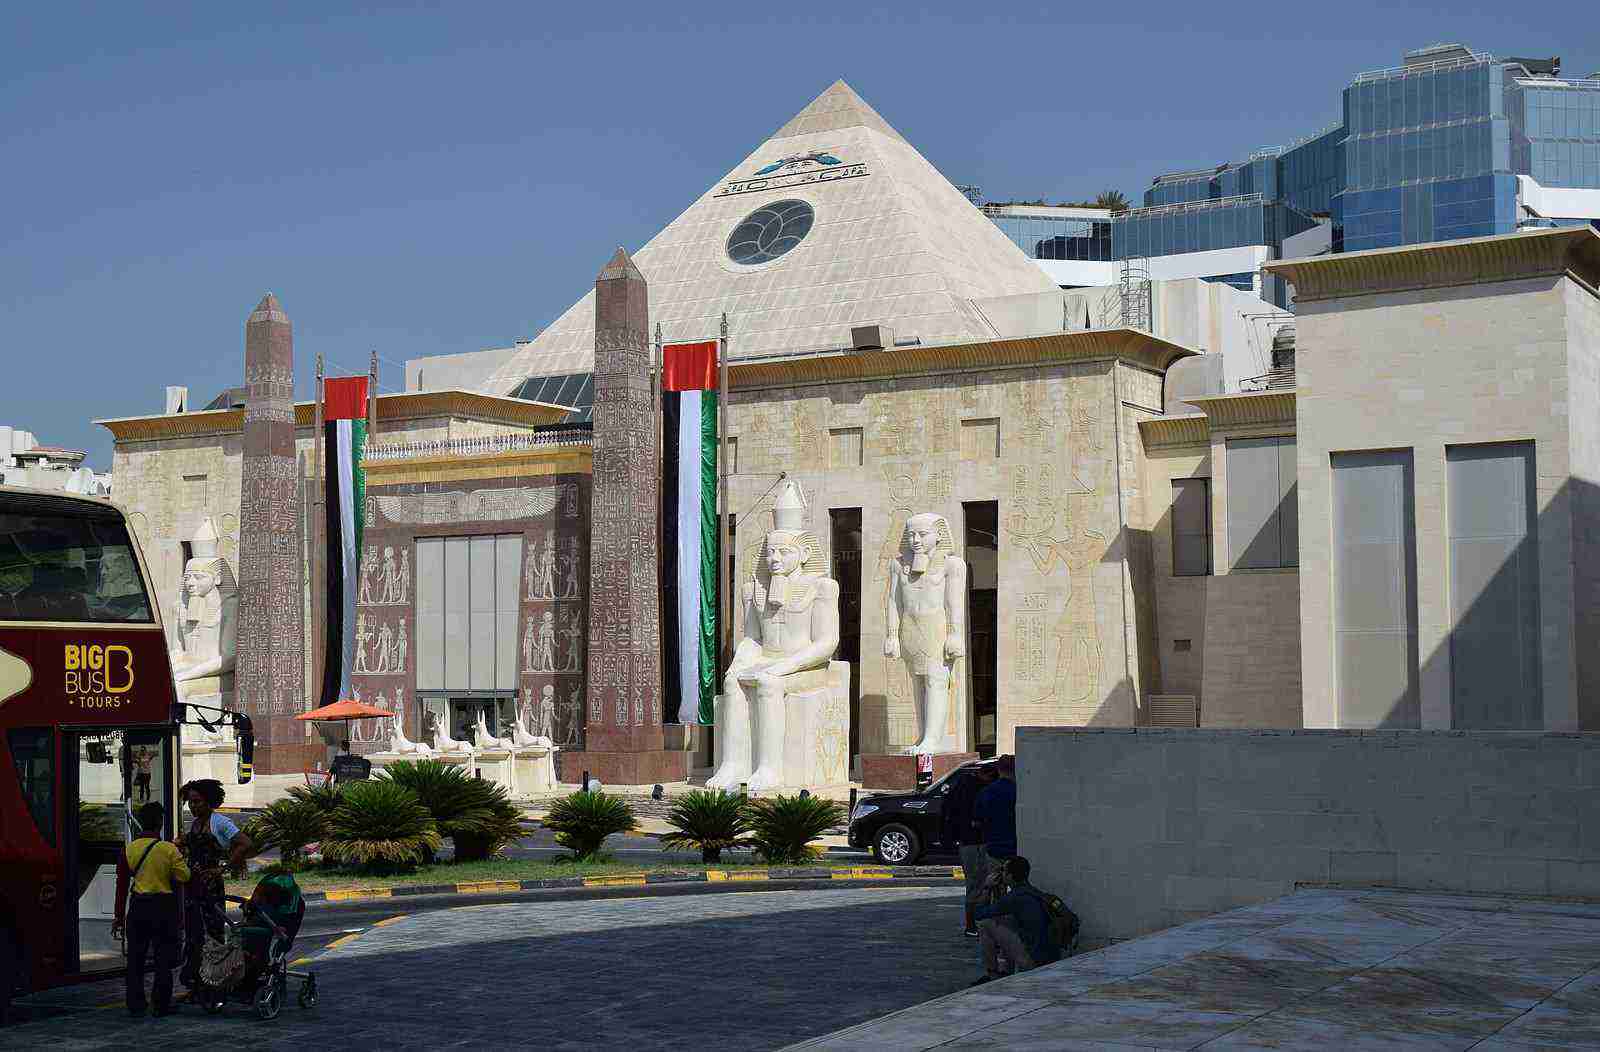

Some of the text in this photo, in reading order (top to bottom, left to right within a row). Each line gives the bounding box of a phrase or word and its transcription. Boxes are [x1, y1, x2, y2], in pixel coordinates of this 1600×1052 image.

[65, 645, 103, 670] BIG
[65, 672, 104, 693] BUS
[79, 696, 120, 708] TOURS
